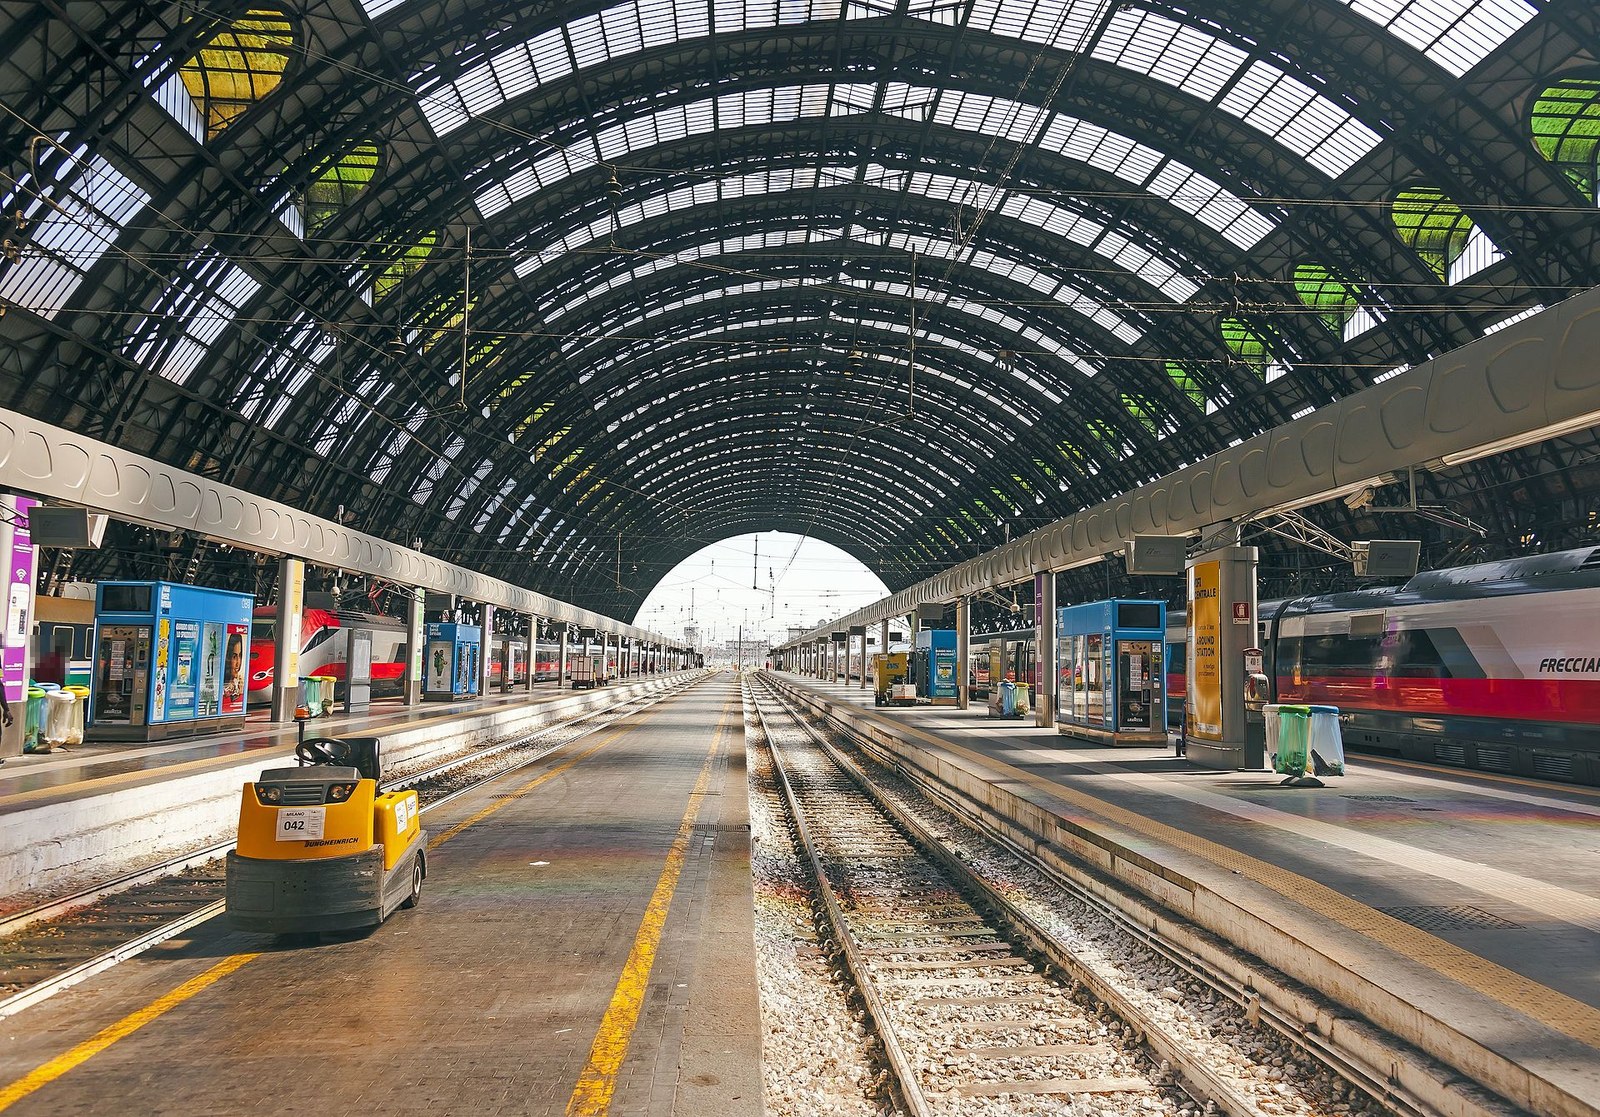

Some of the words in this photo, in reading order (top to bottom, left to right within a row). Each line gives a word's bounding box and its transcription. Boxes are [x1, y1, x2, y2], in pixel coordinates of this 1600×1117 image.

[1197, 636, 1214, 645] AROUND
[1197, 648, 1214, 656] STATION
[284, 821, 305, 831] 042
[304, 838, 359, 847] JUNGHEINRICH
